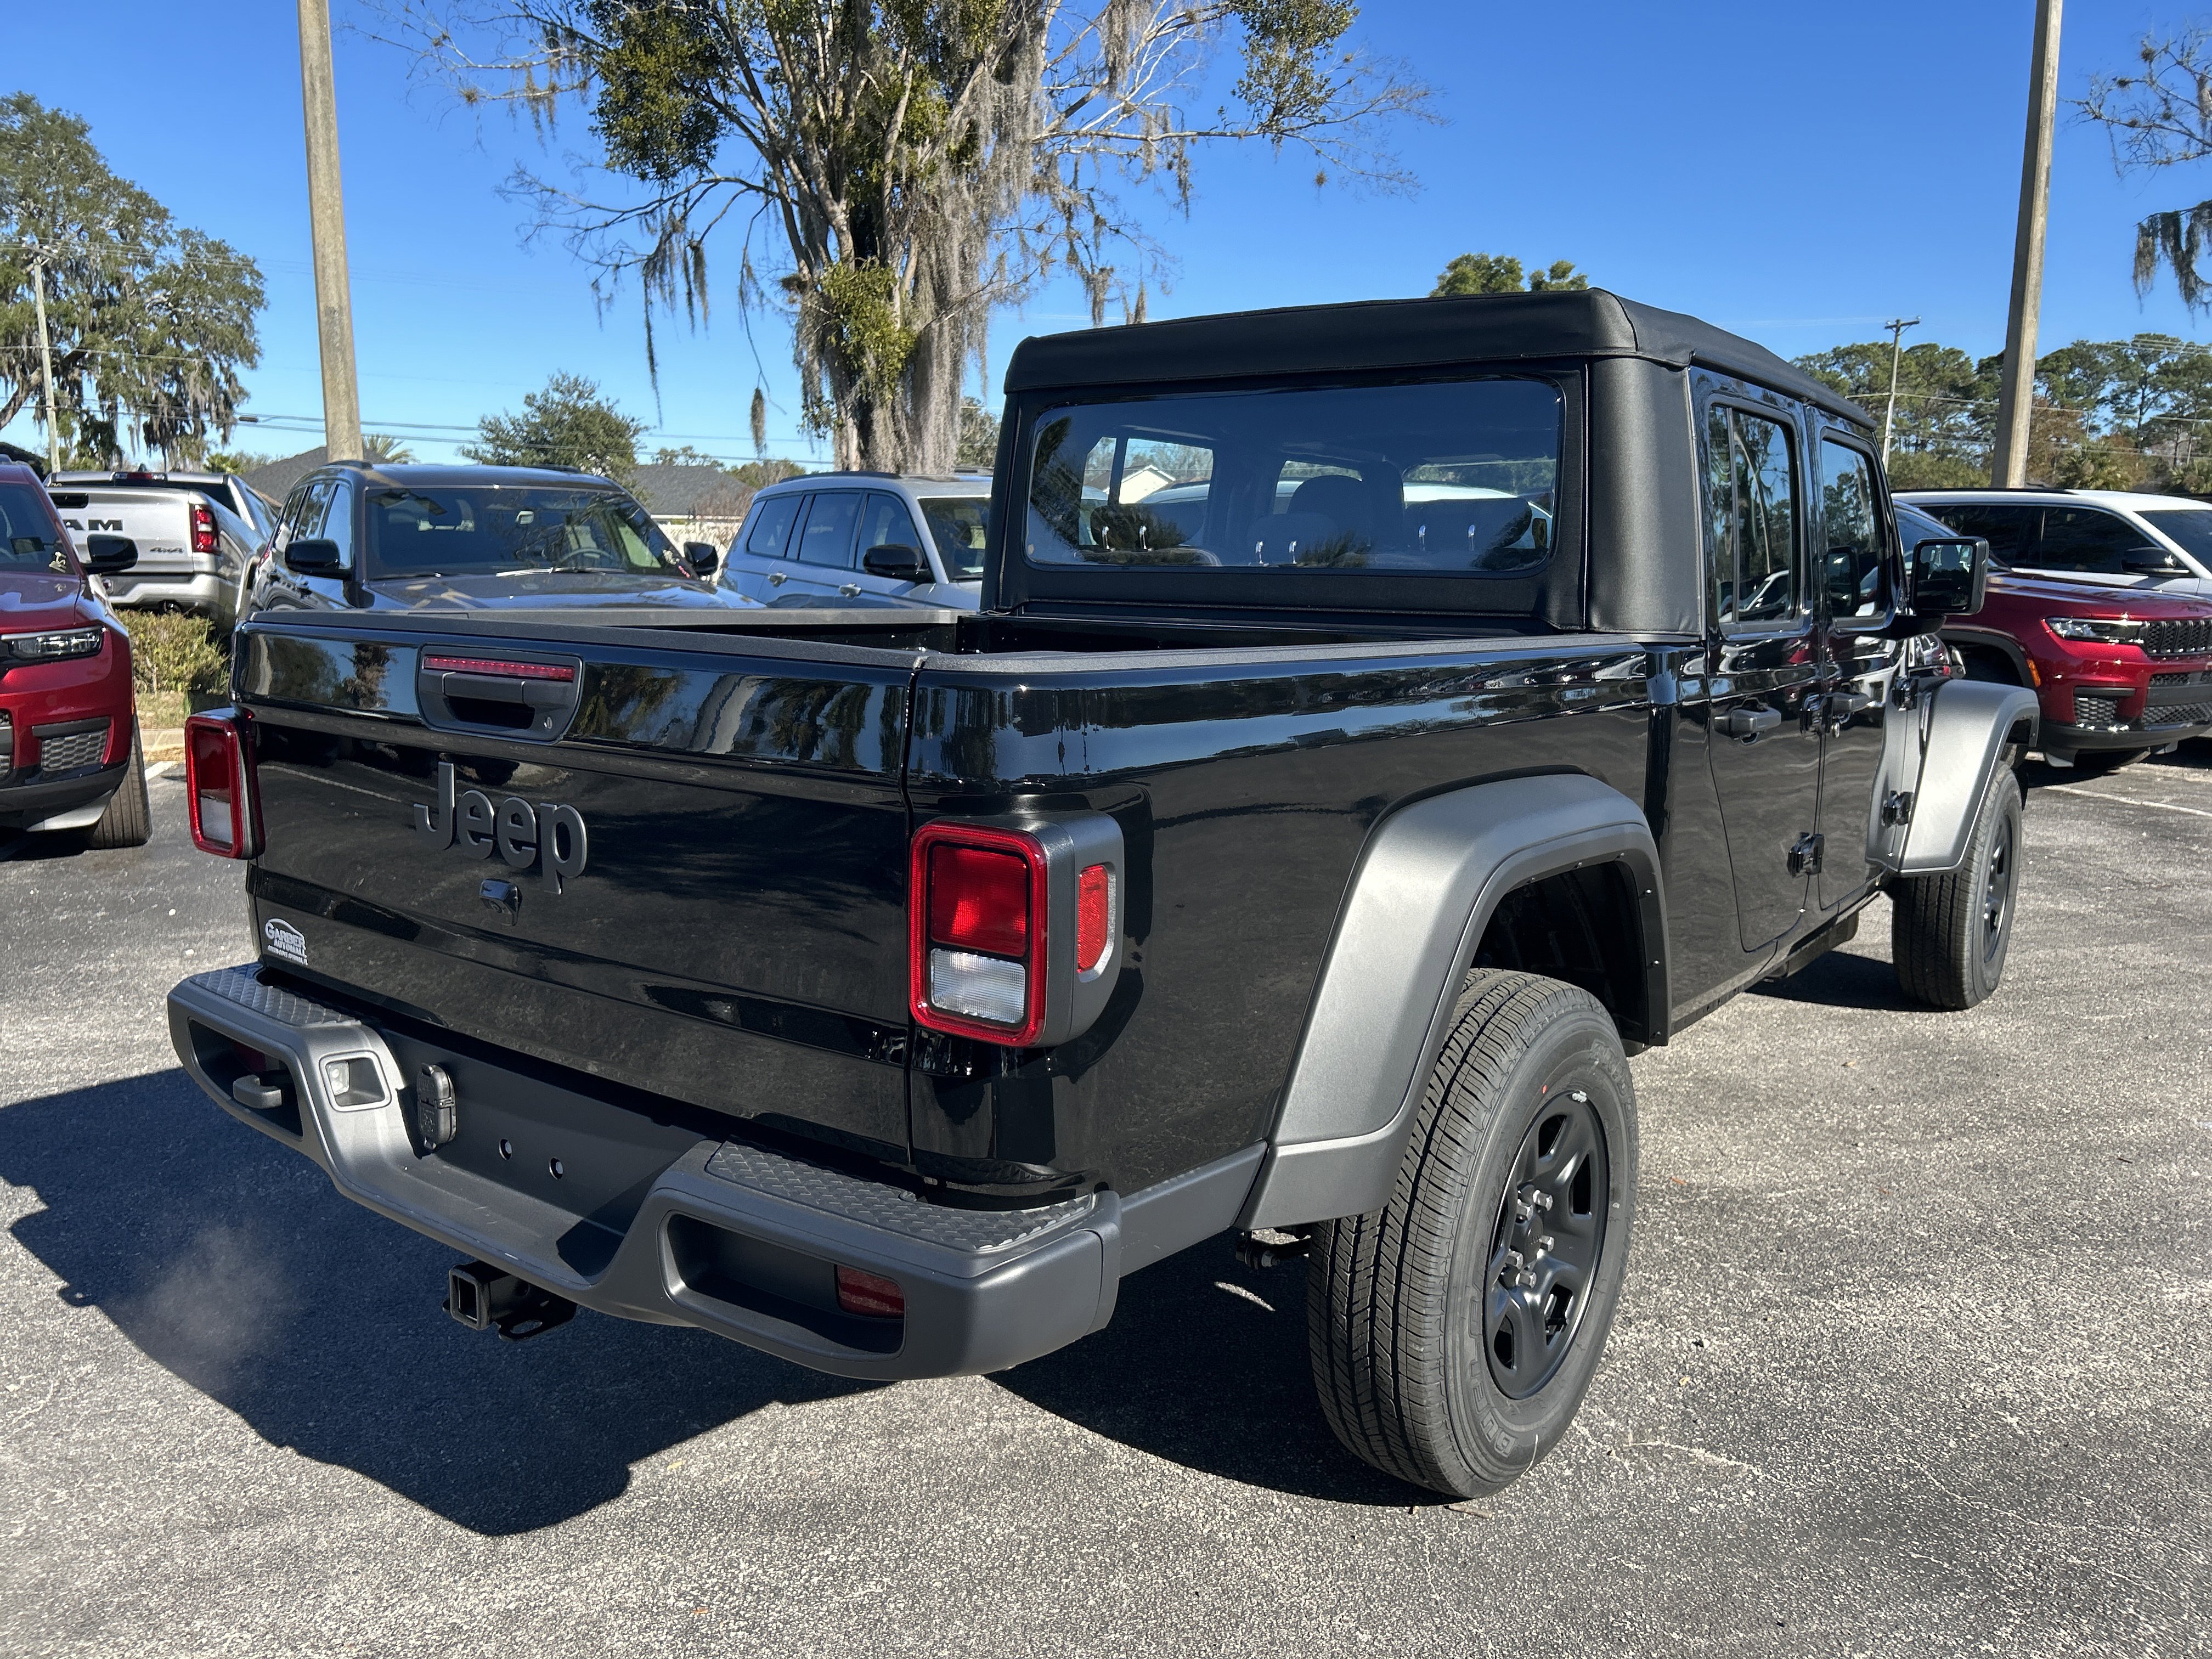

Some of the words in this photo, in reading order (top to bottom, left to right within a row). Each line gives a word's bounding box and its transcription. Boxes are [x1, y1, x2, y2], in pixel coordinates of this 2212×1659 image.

[63, 519, 123, 531] AM
[414, 760, 588, 895] Jeep
[265, 922, 306, 950] GARBER
